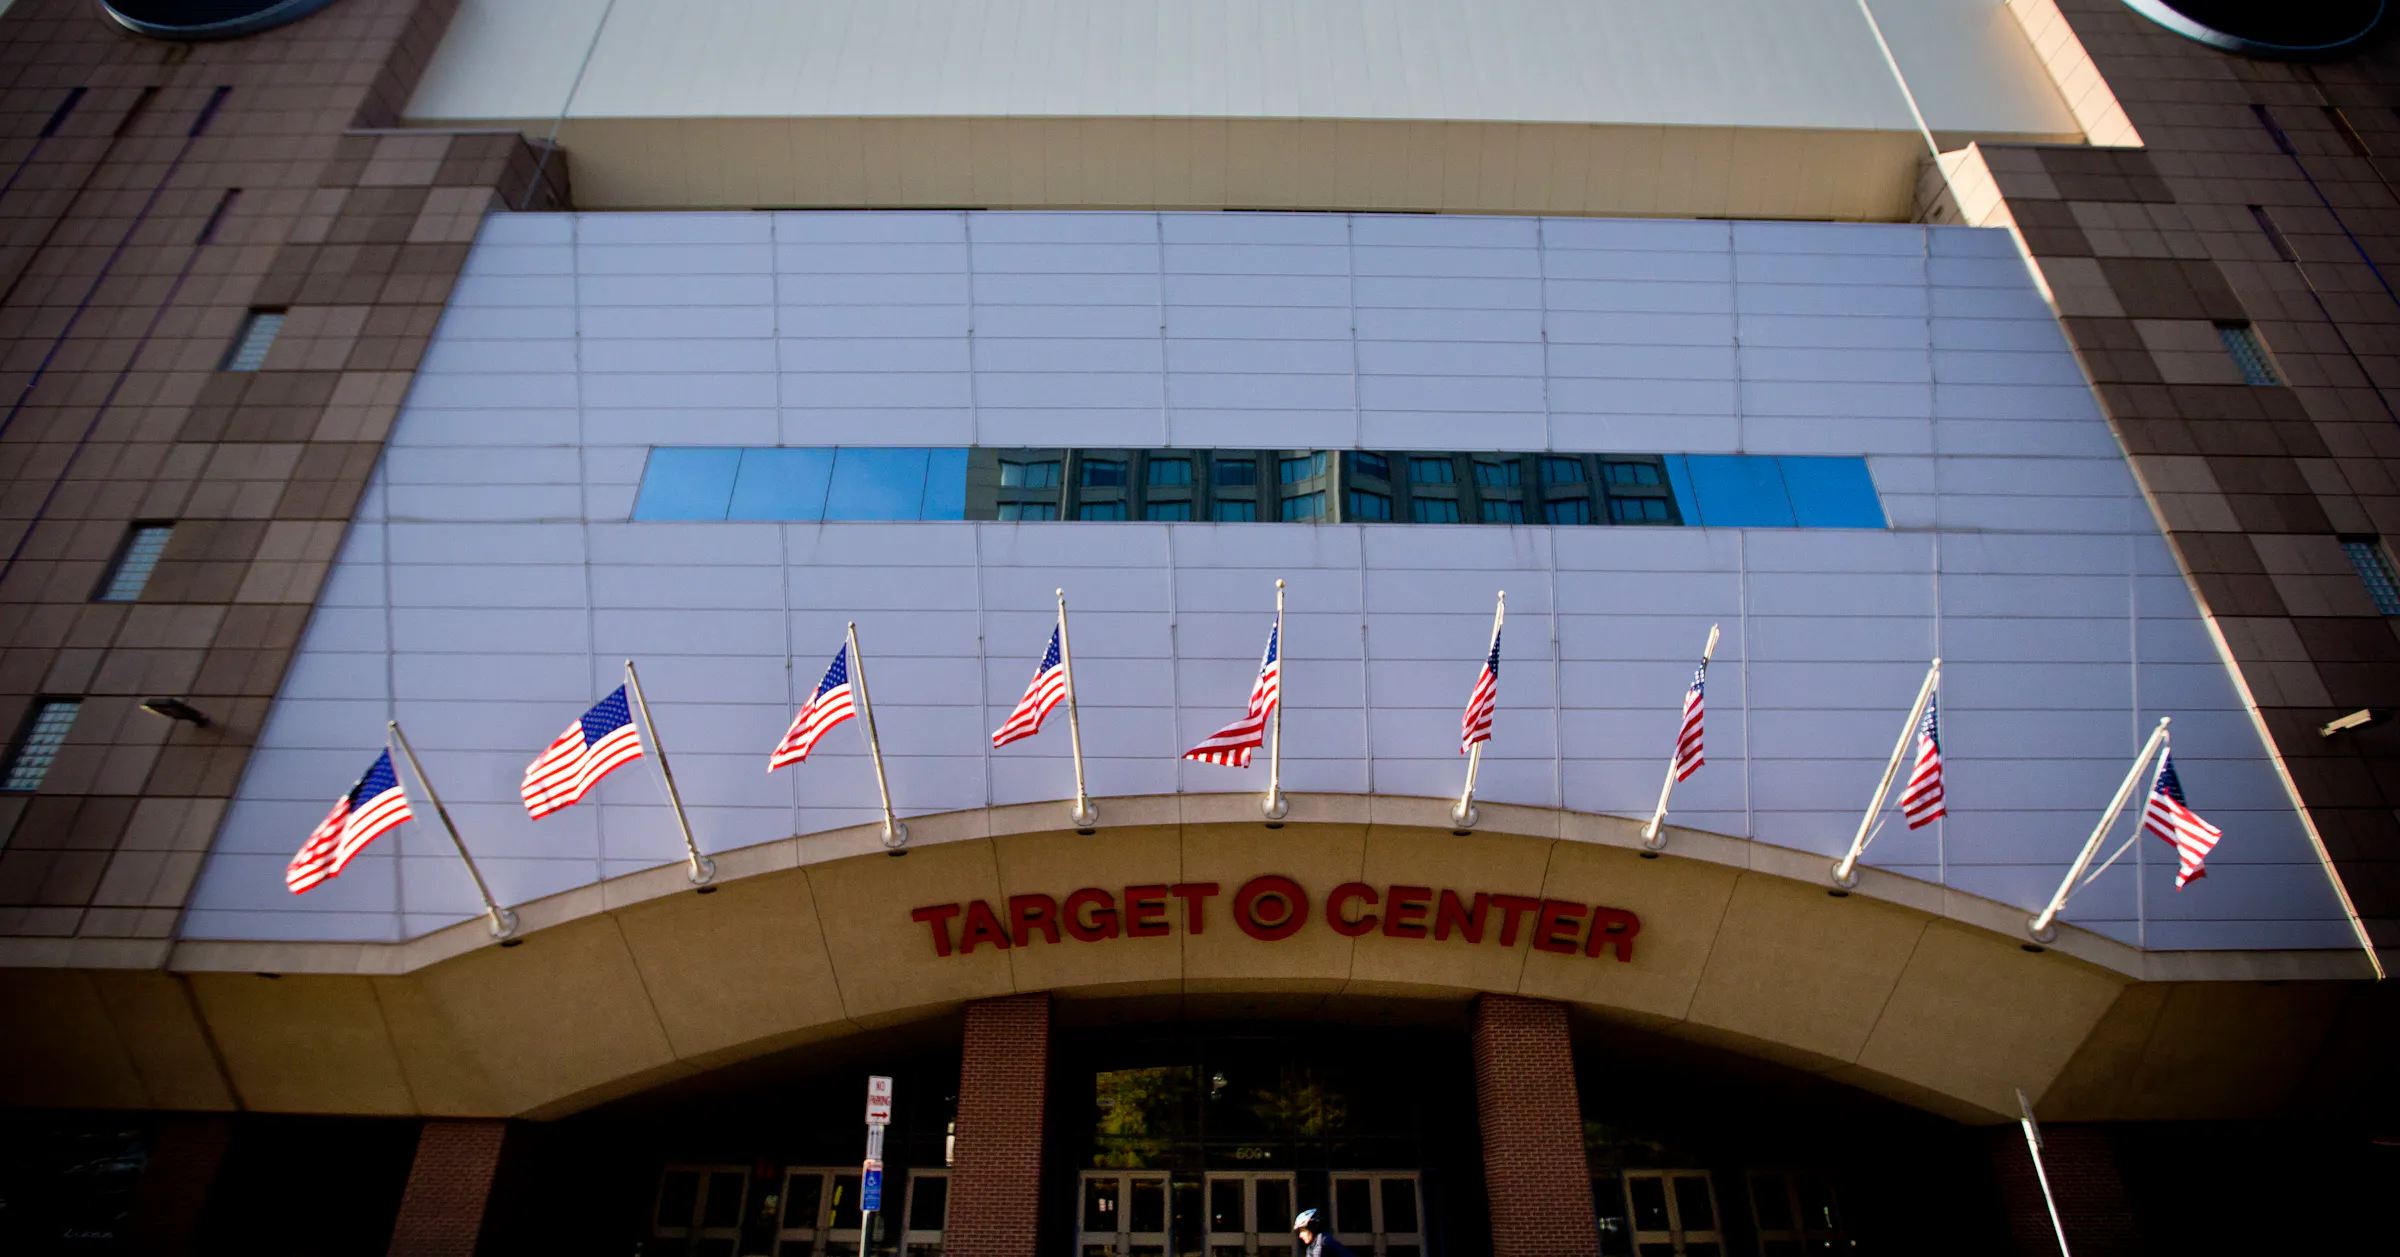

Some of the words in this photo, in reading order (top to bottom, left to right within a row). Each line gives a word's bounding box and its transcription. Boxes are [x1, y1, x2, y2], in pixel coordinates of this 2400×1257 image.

[911, 882, 1219, 957] TARGET
[1326, 882, 1641, 963] CENTER
[875, 1080, 886, 1092] NO
[869, 1095, 891, 1106] PARKING
